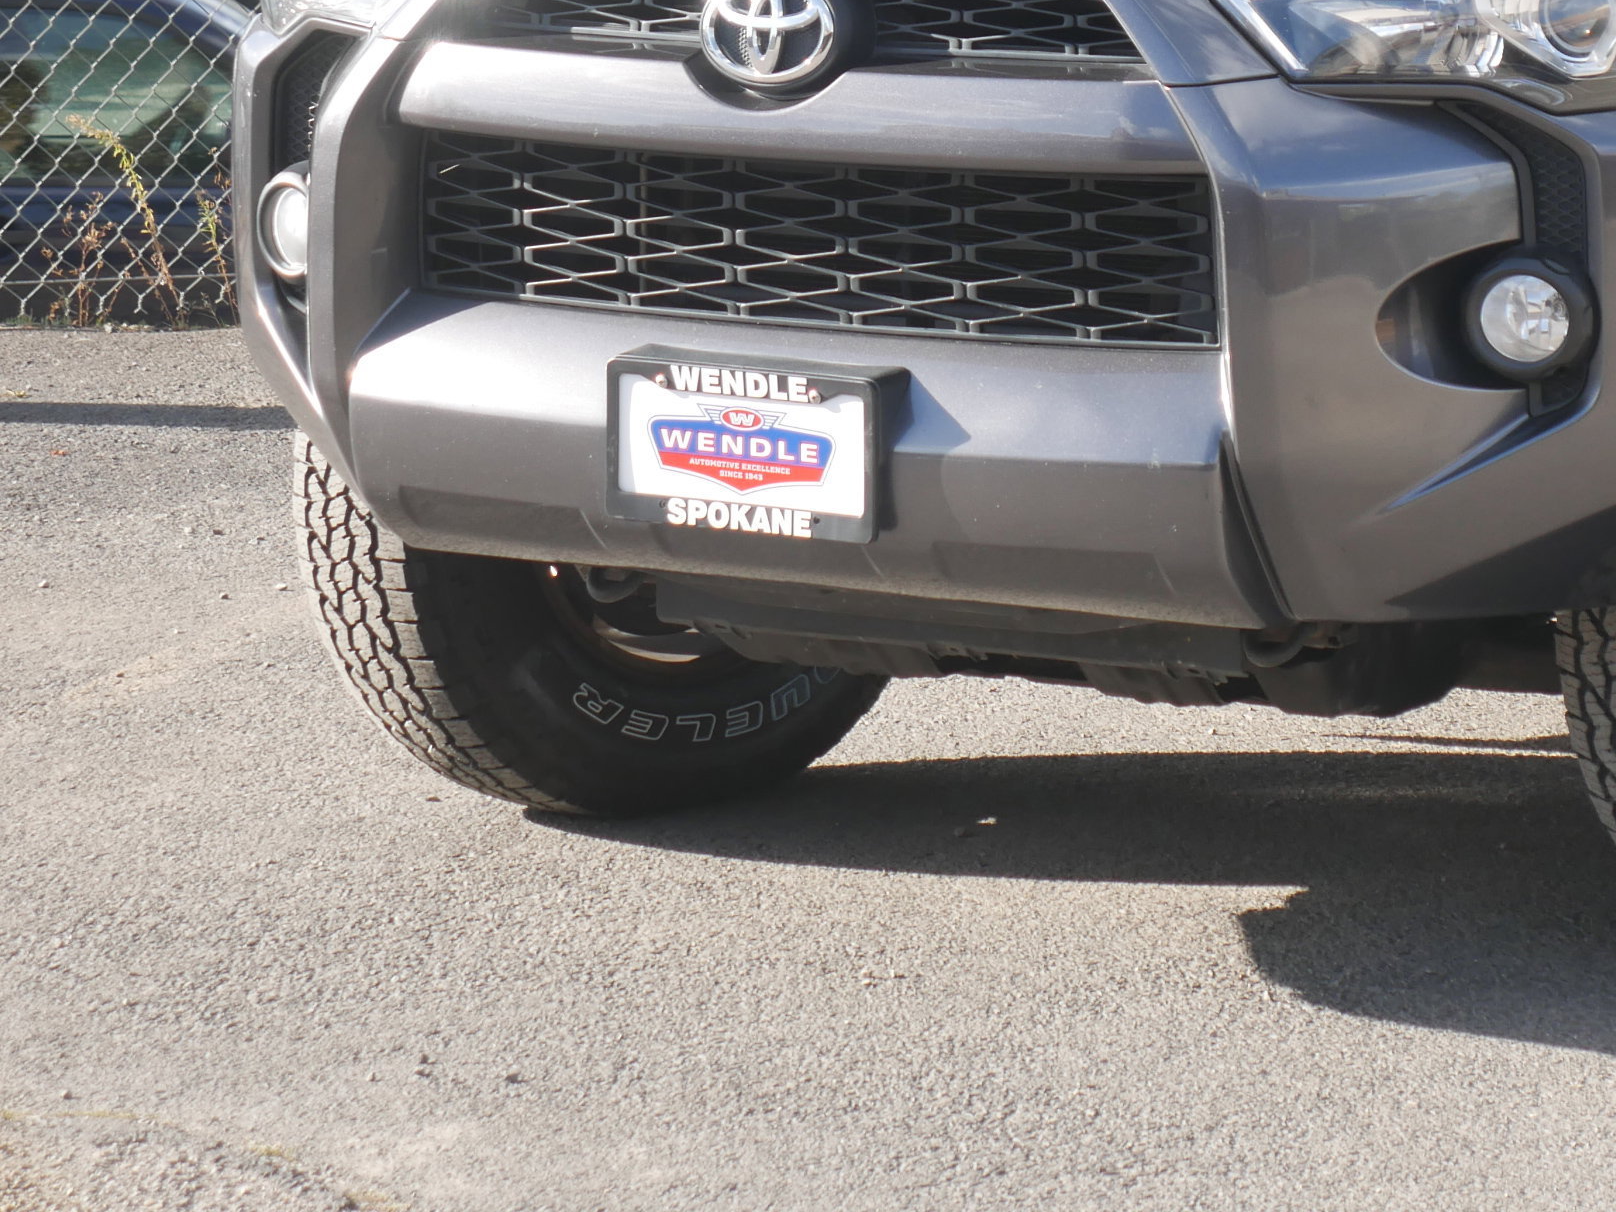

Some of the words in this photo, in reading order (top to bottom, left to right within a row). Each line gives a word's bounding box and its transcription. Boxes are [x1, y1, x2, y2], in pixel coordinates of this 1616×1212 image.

[670, 365, 810, 403] WENDLE
[661, 428, 818, 463] WENDLE
[689, 457, 740, 470] AUTOMOTIVE
[741, 463, 791, 475] EXCELLENCE
[719, 469, 743, 480] SINCE
[744, 471, 763, 481] 1943
[666, 498, 812, 538] SPOKANE
